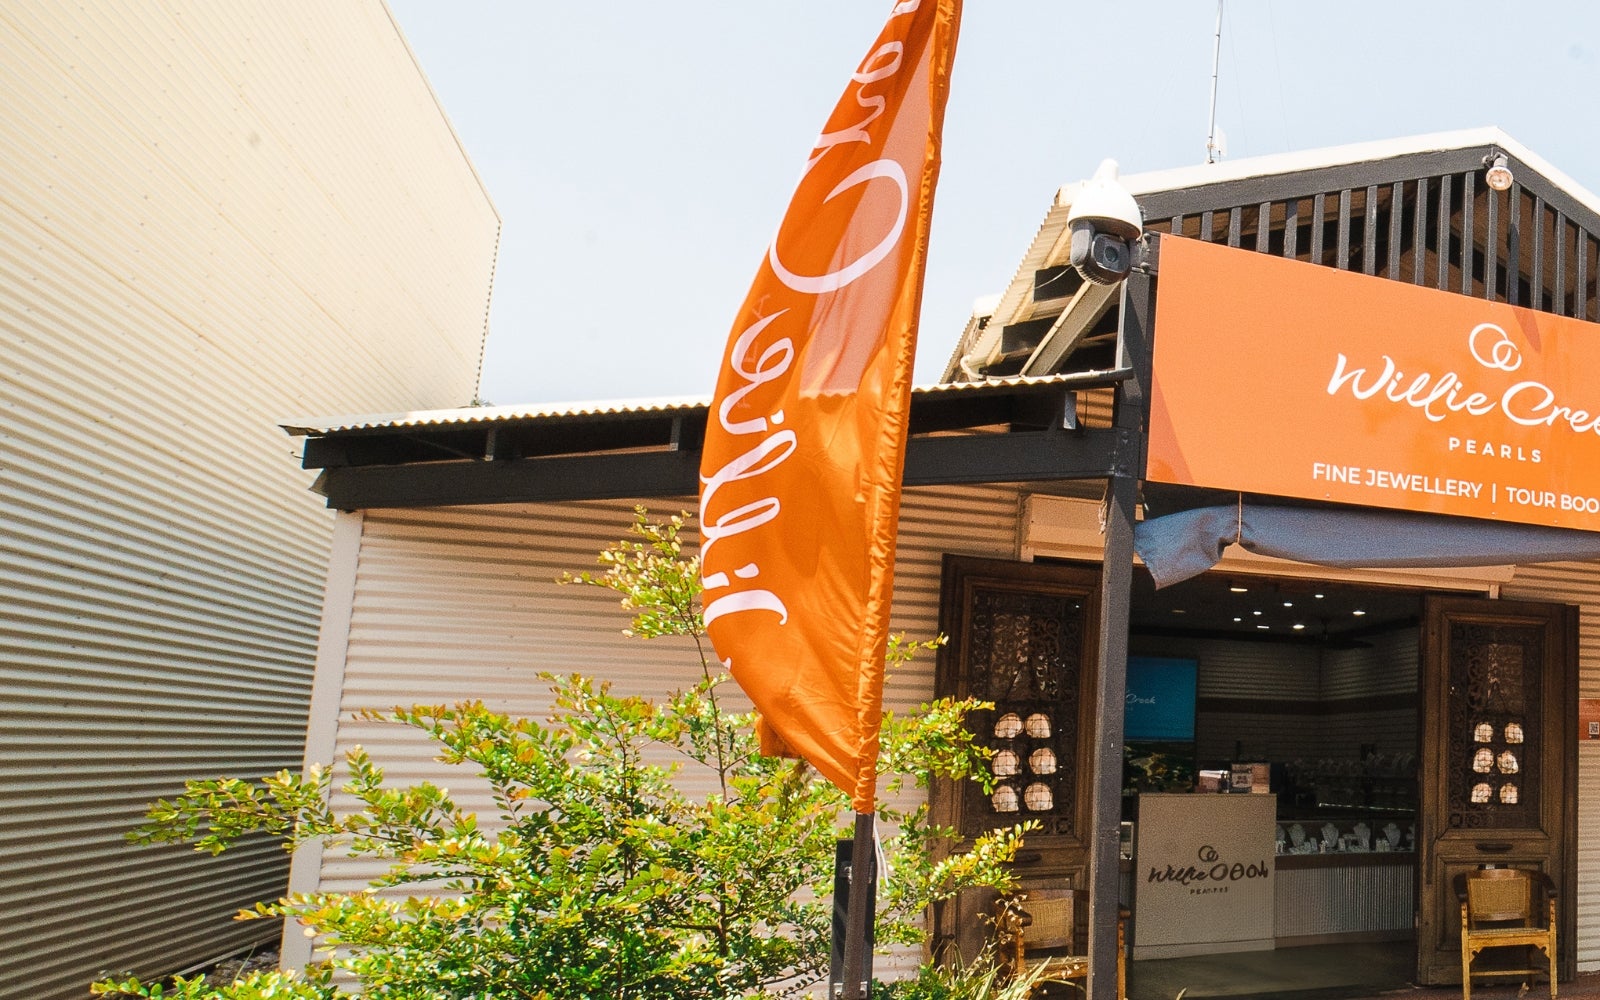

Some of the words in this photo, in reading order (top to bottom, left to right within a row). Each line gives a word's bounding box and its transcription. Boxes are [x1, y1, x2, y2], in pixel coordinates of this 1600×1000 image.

[1327, 353, 1497, 422] Willie
[1448, 437, 1542, 463] PEARLS
[1312, 463, 1361, 485] FINE
[1365, 469, 1483, 499] JEWELLERY
[1506, 486, 1556, 508] TOUR
